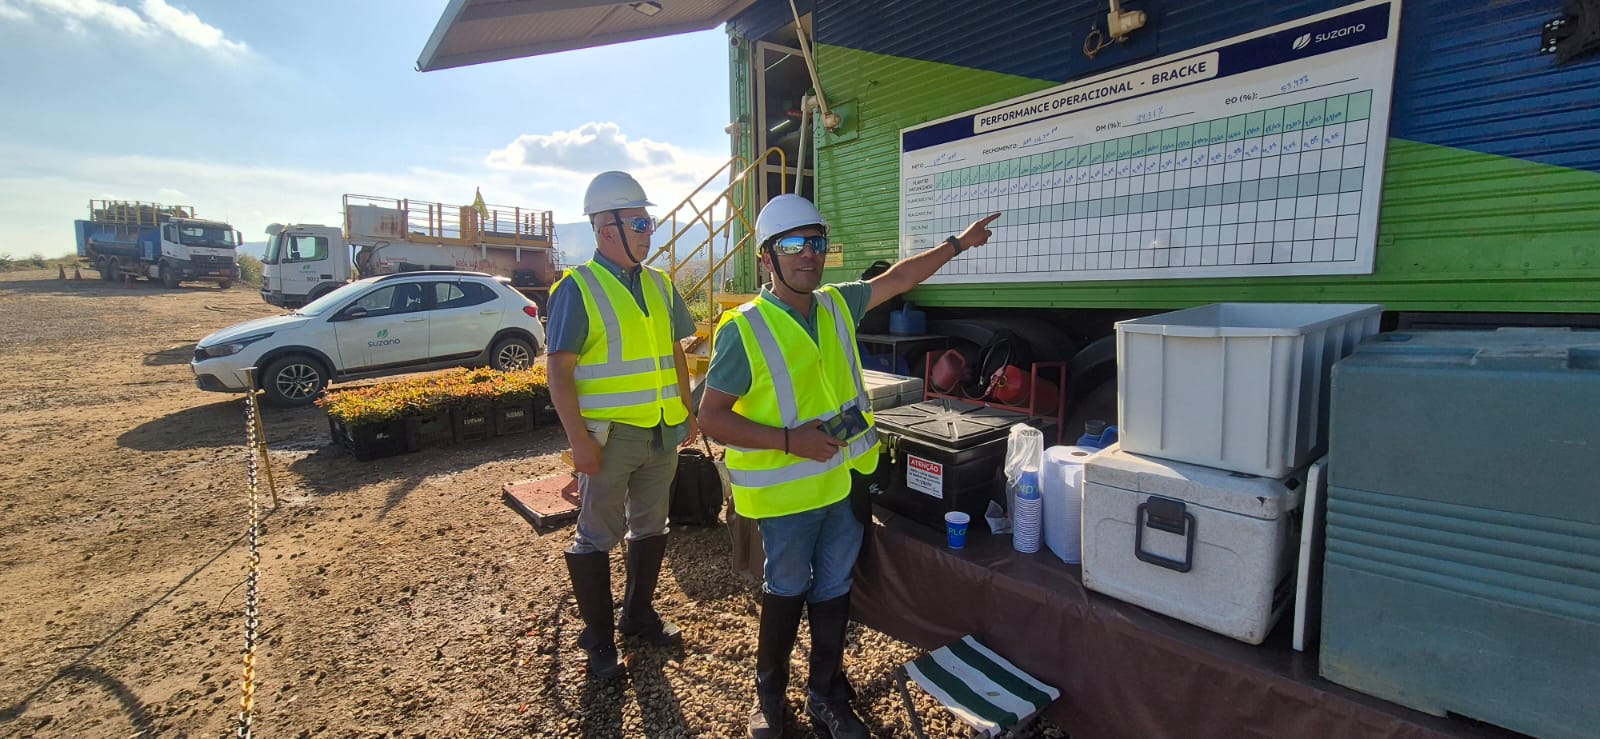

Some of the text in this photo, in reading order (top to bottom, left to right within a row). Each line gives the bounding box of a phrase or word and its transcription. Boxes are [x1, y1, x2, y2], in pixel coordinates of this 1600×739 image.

[1315, 23, 1366, 43] suzano
[980, 101, 1050, 127] PERFORMANCE
[1052, 81, 1134, 110] OPERACIONAL
[1152, 61, 1207, 86] BRACKE
[367, 338, 401, 347] suzano
[911, 459, 939, 473] ATENÇÃO
